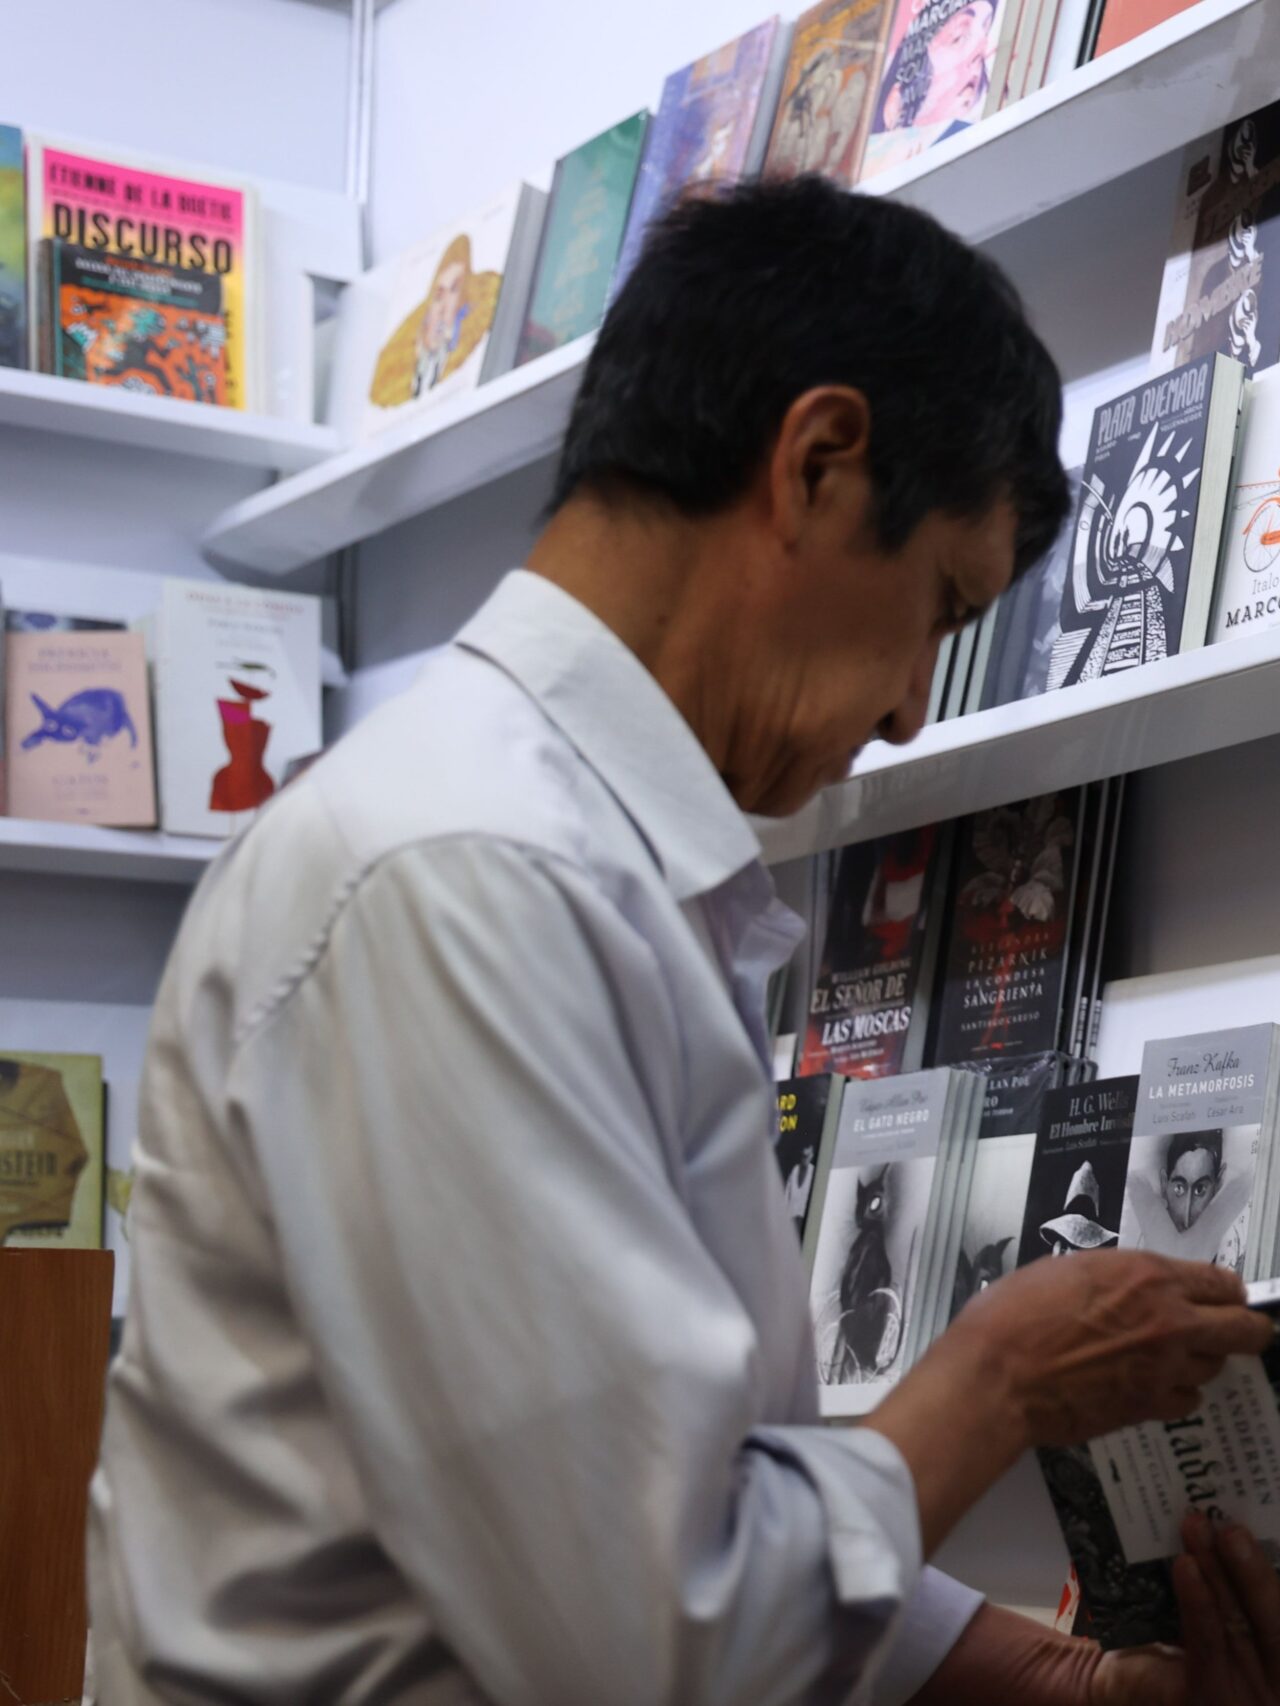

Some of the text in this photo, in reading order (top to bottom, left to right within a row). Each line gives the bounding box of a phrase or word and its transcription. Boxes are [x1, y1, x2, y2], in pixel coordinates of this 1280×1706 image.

[54, 203, 231, 274] DISCURSO
[1098, 363, 1209, 448] PLATA QUEMADA
[1252, 573, 1279, 595] Italo
[968, 947, 1047, 973] PIZARNIK
[985, 967, 1045, 986] CONDESA
[810, 989, 829, 1013] EL
[833, 978, 882, 1008] SEÑOR
[885, 973, 907, 998] DE
[963, 981, 1043, 1009] SANGRIENTA
[822, 1018, 851, 1046] LAS
[851, 1006, 911, 1040] MOSCAS
[1167, 1050, 1240, 1077] Franz Kafka
[1148, 1073, 1255, 1100] LA METAMORFOSIS
[776, 1093, 797, 1110] RD
[1069, 1098, 1081, 1117] H.
[1083, 1096, 1095, 1115] G.
[852, 1109, 930, 1133] EL GATO NEGRO
[1051, 1123, 1062, 1139] El
[1062, 1118, 1099, 1136] Hombre
[1207, 1402, 1240, 1474] CUENTOS
[1222, 1386, 1276, 1508] ANDERSEN
